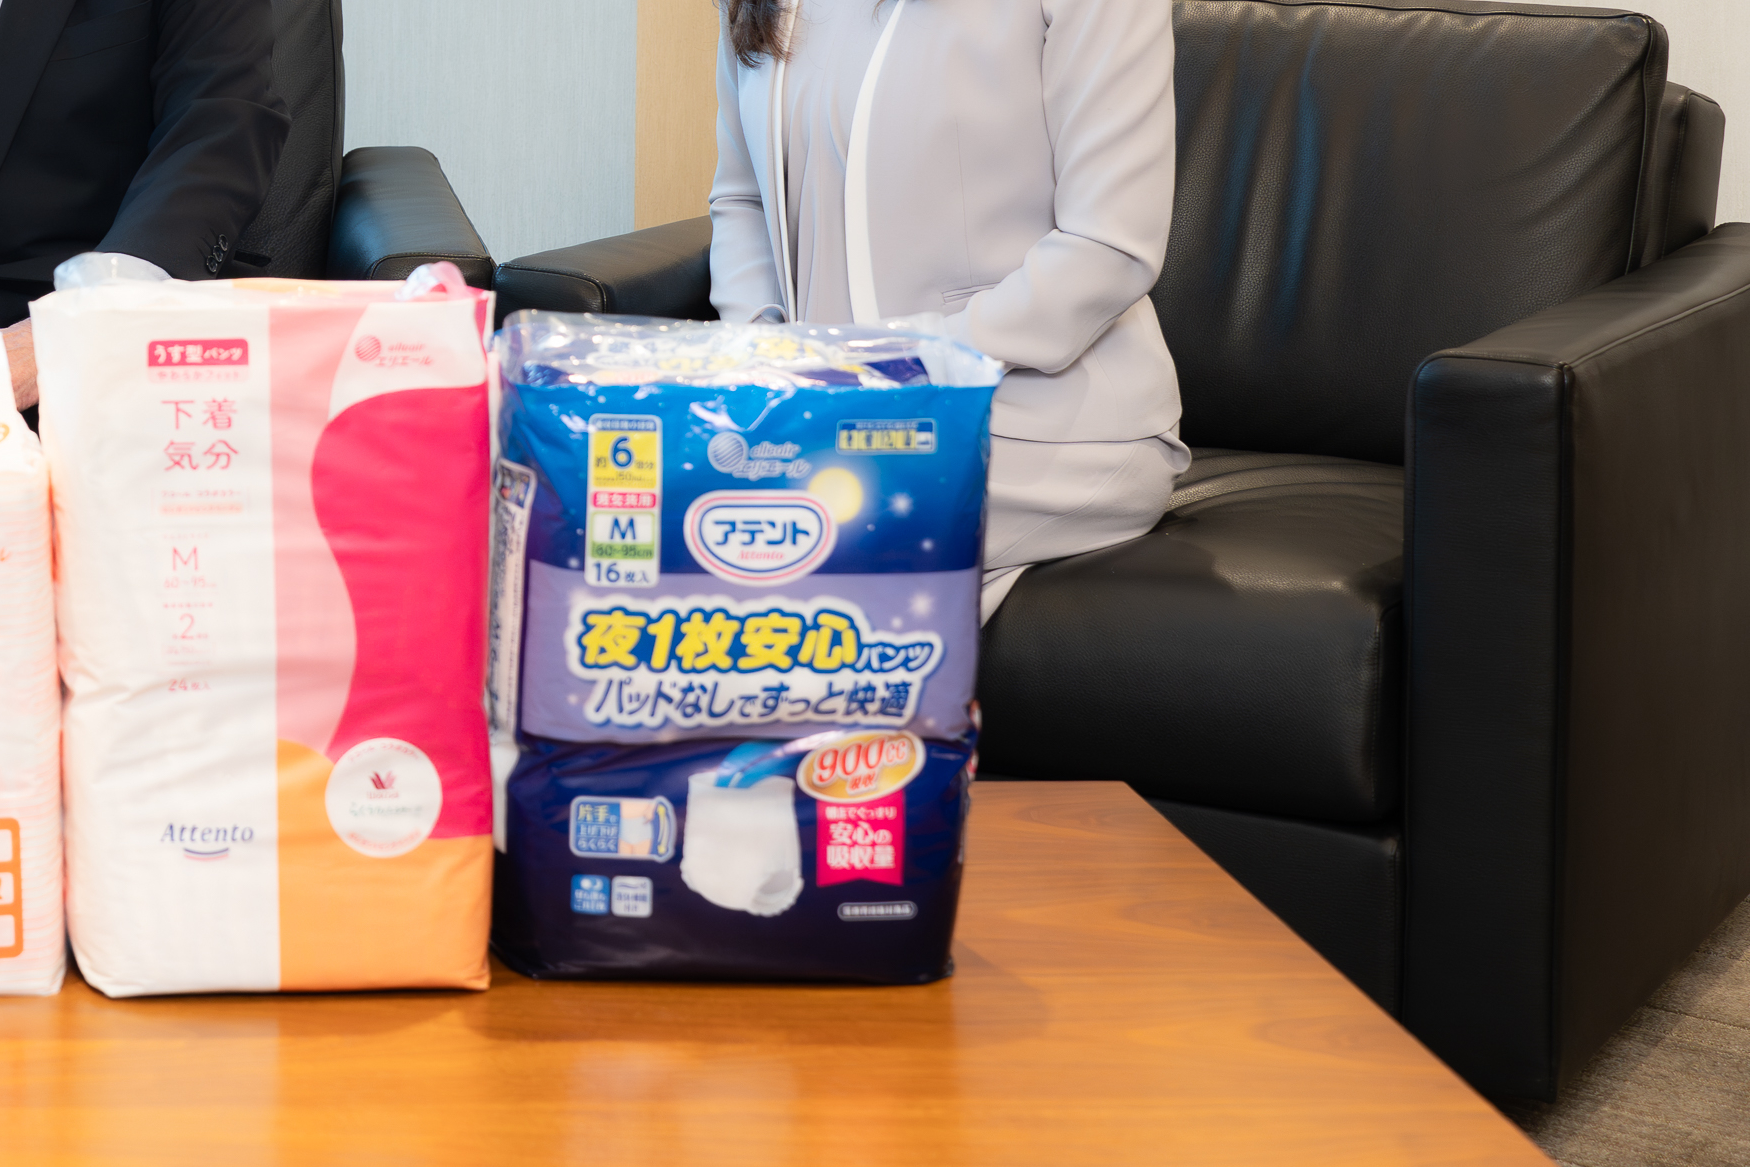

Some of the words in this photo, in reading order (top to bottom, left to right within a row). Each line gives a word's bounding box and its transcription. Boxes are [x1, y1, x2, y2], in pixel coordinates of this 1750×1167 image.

[154, 344, 243, 364] うす型パンツ
[160, 397, 238, 430] 下着
[163, 439, 239, 471] 気分
[610, 517, 636, 540] M
[713, 520, 810, 546] アテント
[172, 546, 199, 571] M
[579, 608, 936, 674] 夜1枚安心パンツ
[594, 677, 914, 720] パッドなしでずっと快適
[816, 736, 907, 783] 900cc
[159, 822, 254, 843] Attento
[829, 821, 893, 845] 安心の
[826, 845, 896, 869] 吸収量
